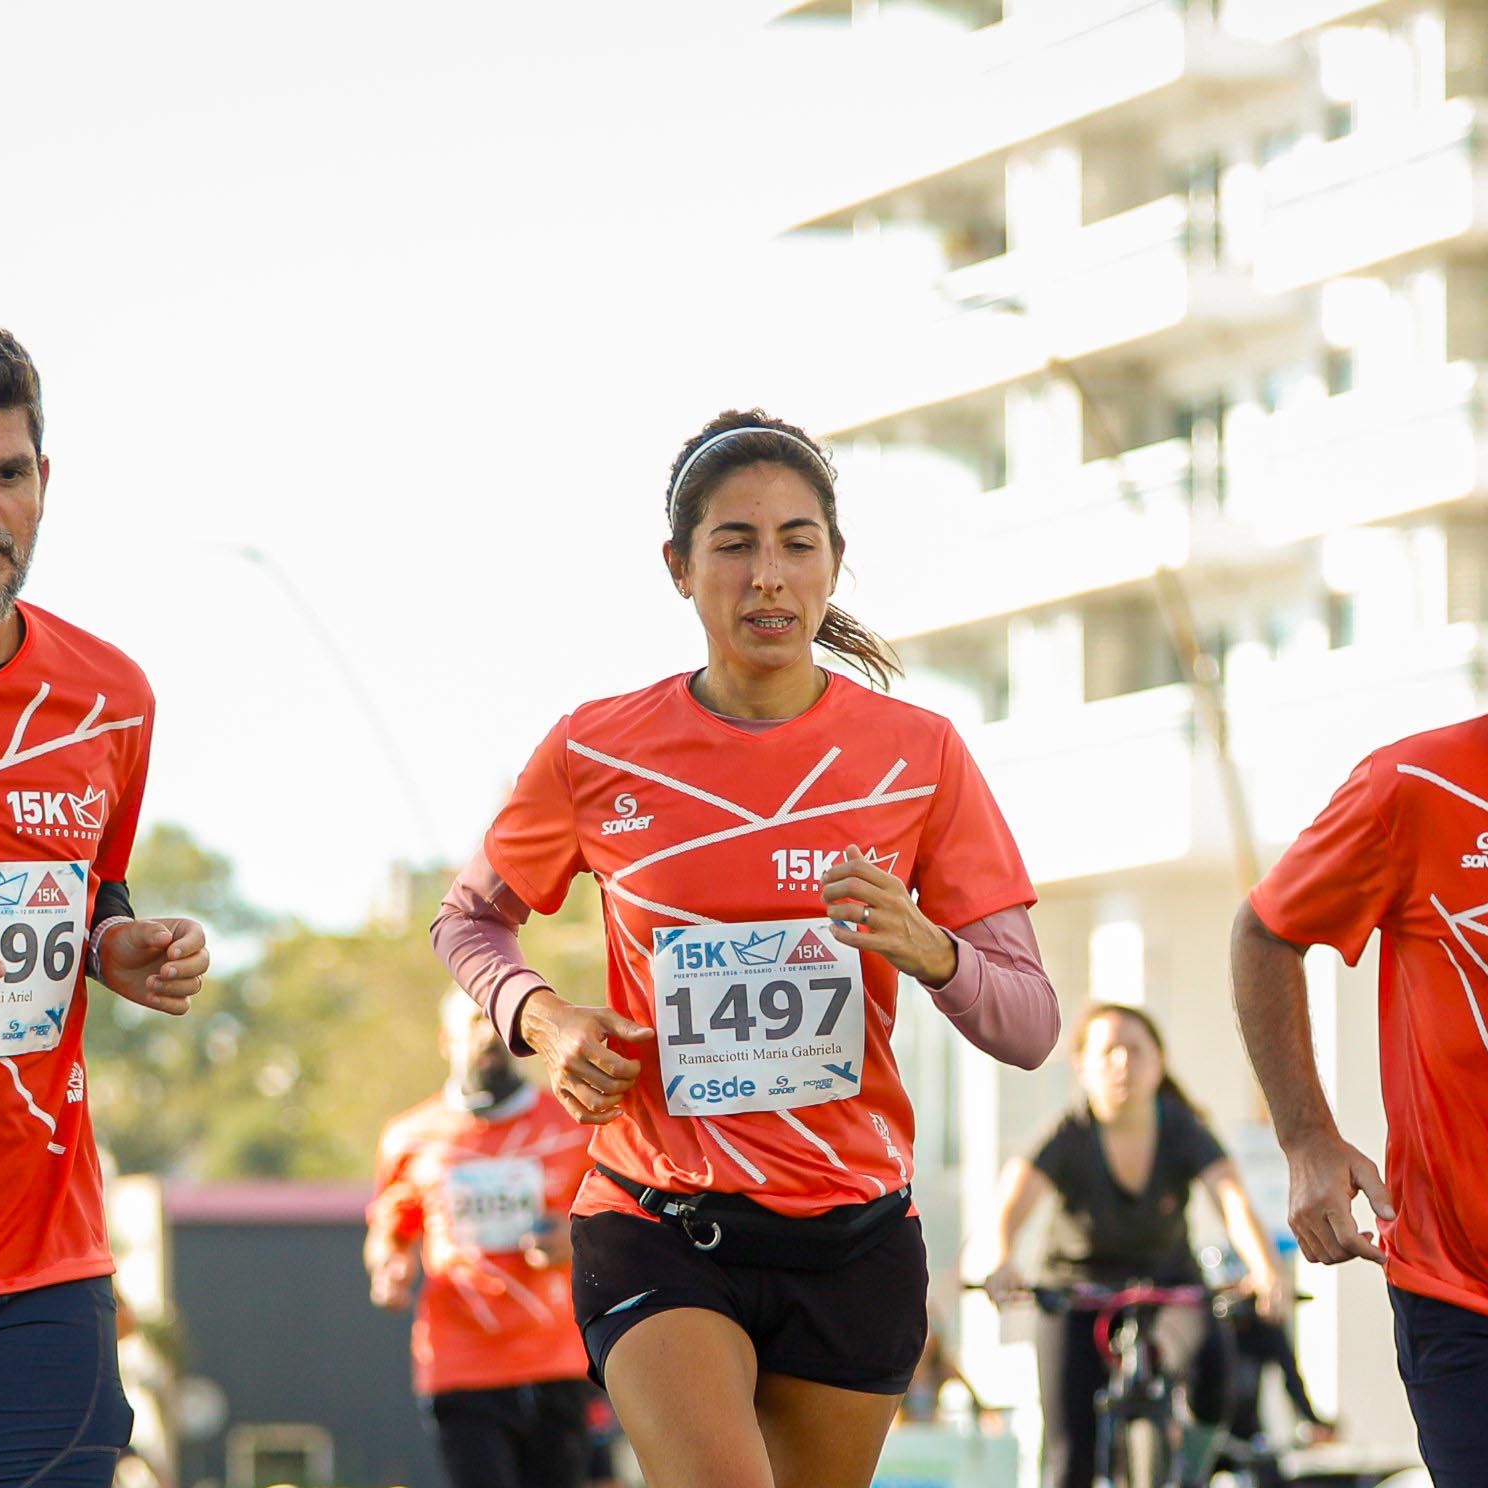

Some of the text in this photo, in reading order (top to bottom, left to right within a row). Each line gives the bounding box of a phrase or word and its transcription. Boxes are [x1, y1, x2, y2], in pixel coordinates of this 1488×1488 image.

[6, 791, 69, 825] 15K
[16, 826, 69, 837] PUERTO
[772, 849, 841, 881] 15K
[37, 888, 61, 902] 15K
[777, 883, 819, 892] PUER
[672, 941, 728, 970] 15K
[796, 944, 825, 960] 15K
[8, 990, 33, 1003] Ariel
[665, 977, 852, 1046] 1497
[678, 1043, 842, 1065] Ramacciotti Maria Gabriela
[689, 1076, 756, 1103] osde
